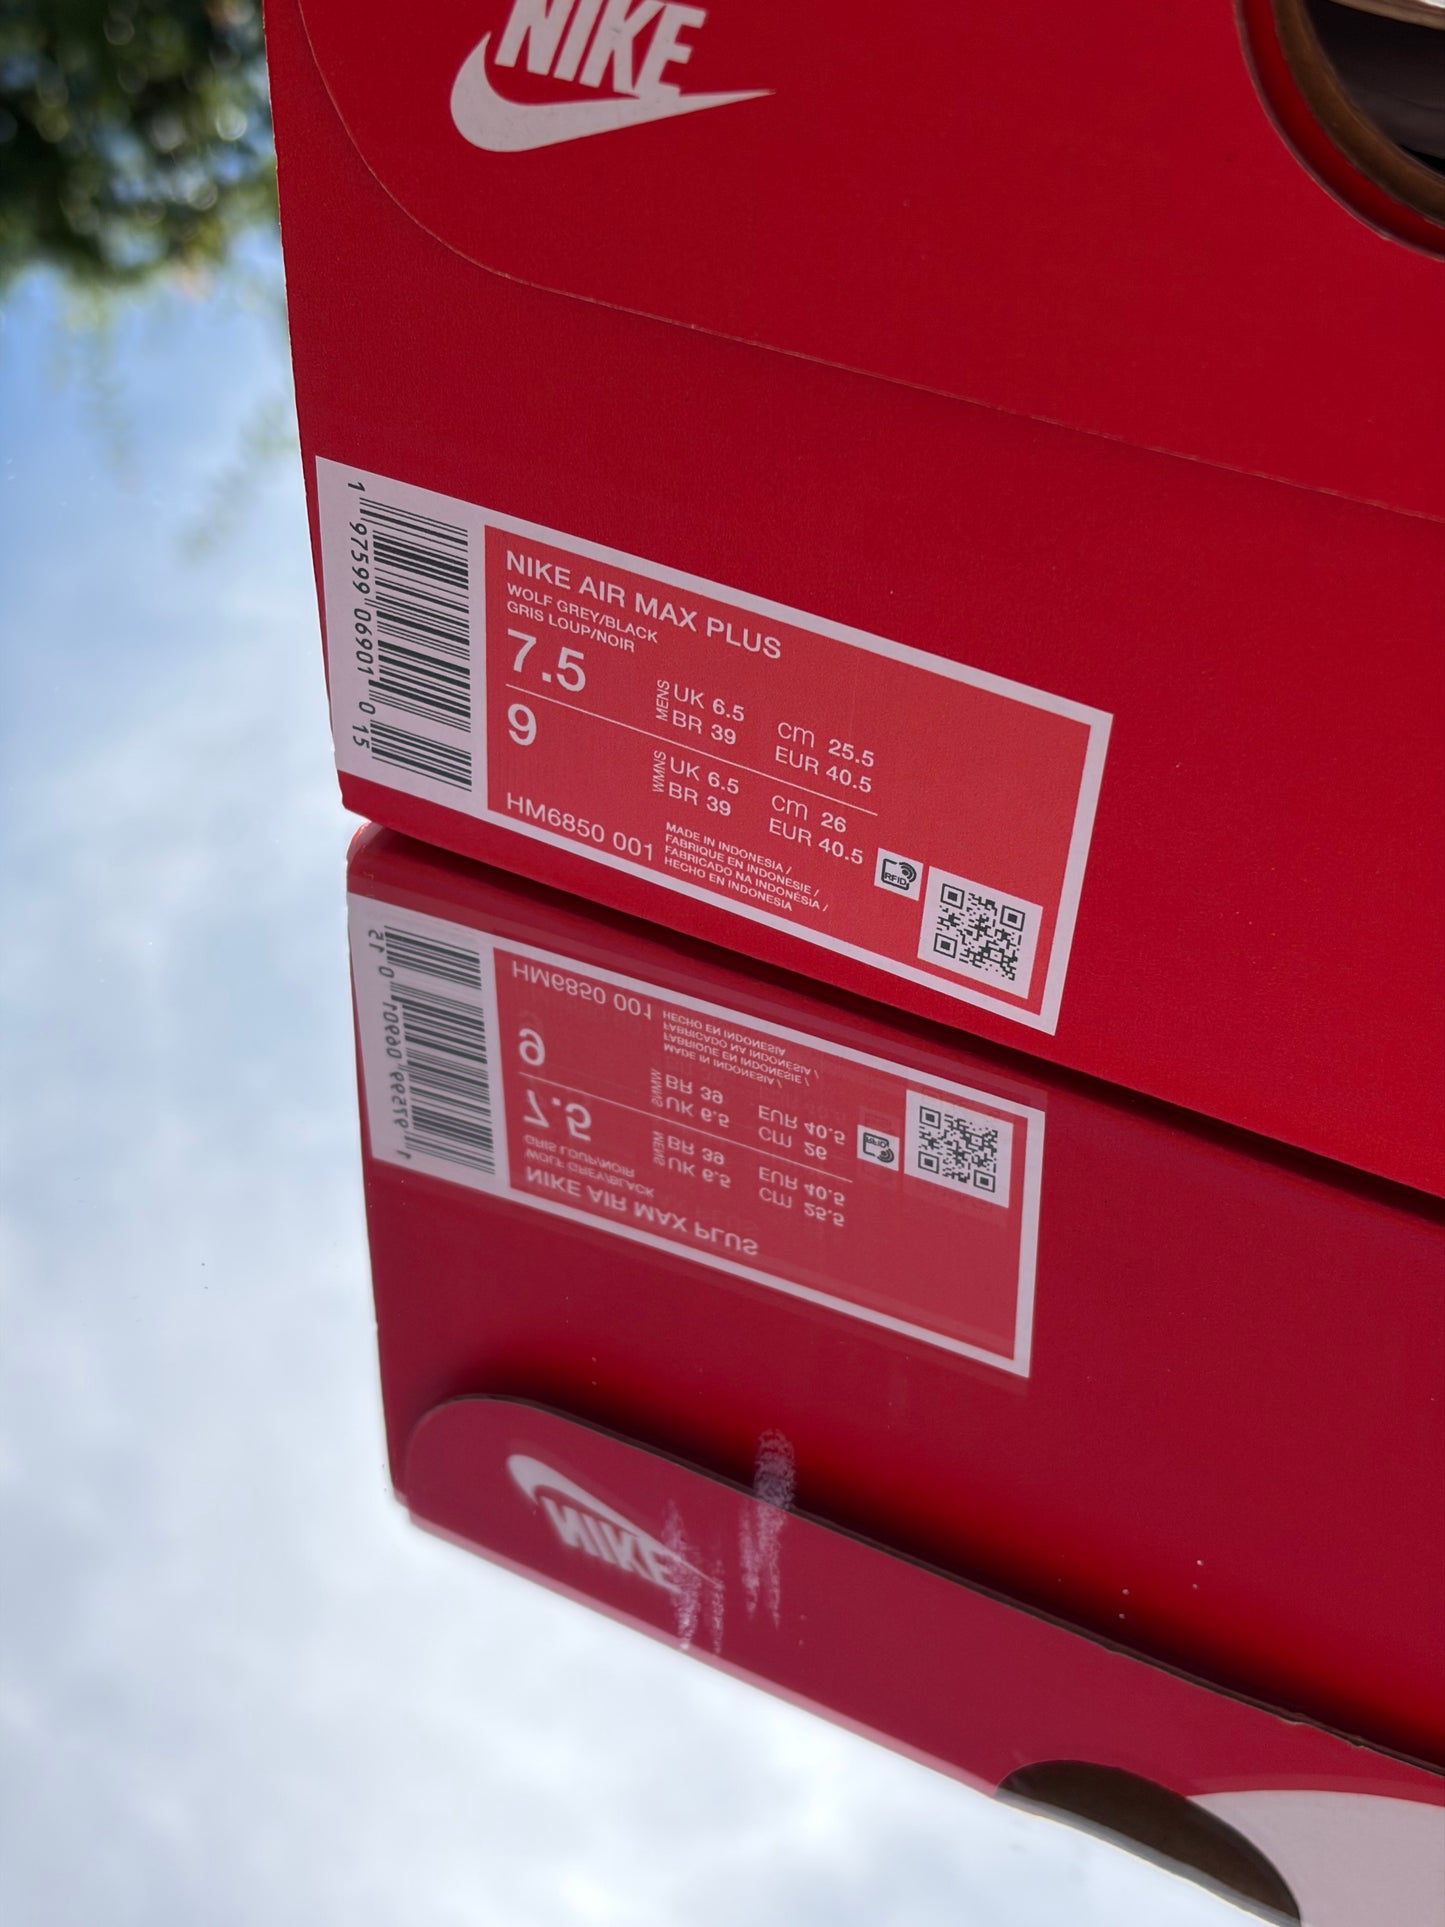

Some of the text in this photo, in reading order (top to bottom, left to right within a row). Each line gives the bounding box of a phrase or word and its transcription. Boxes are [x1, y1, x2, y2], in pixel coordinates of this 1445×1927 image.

[494, 0, 706, 99] NIKE
[347, 480, 376, 750] 1 97599 06901 0 15
[506, 550, 781, 659] NIKE AIR MAX PLUS
[507, 583, 658, 643] WOLF GREY/BLACK
[507, 602, 634, 653] GRIS LOUP/NOIR
[507, 629, 586, 692] 7.5
[656, 680, 670, 721] MENS
[674, 684, 744, 721] UK 6.5
[508, 703, 537, 746] 9
[673, 710, 736, 745] BR 39
[778, 722, 874, 768] cm 25.5
[653, 750, 666, 793] WMNS
[670, 757, 739, 794] UK 6.5
[775, 746, 872, 793] EUR 40.5
[668, 782, 731, 816] BR 39
[772, 795, 846, 833] cm 26
[506, 792, 653, 861] HM6850 001
[666, 822, 700, 840] MADE
[703, 835, 715, 848] IN
[718, 841, 784, 873] INDONESIA
[769, 818, 864, 865] EUR 40.5
[664, 856, 793, 911] HECHO EN INDONESIA
[665, 834, 725, 863] FABRIQUE
[728, 856, 744, 870] EN
[747, 863, 811, 895] INDONESIE
[665, 845, 732, 877] FABRICADO
[736, 871, 752, 884] NA
[884, 872, 907, 886] RFID
